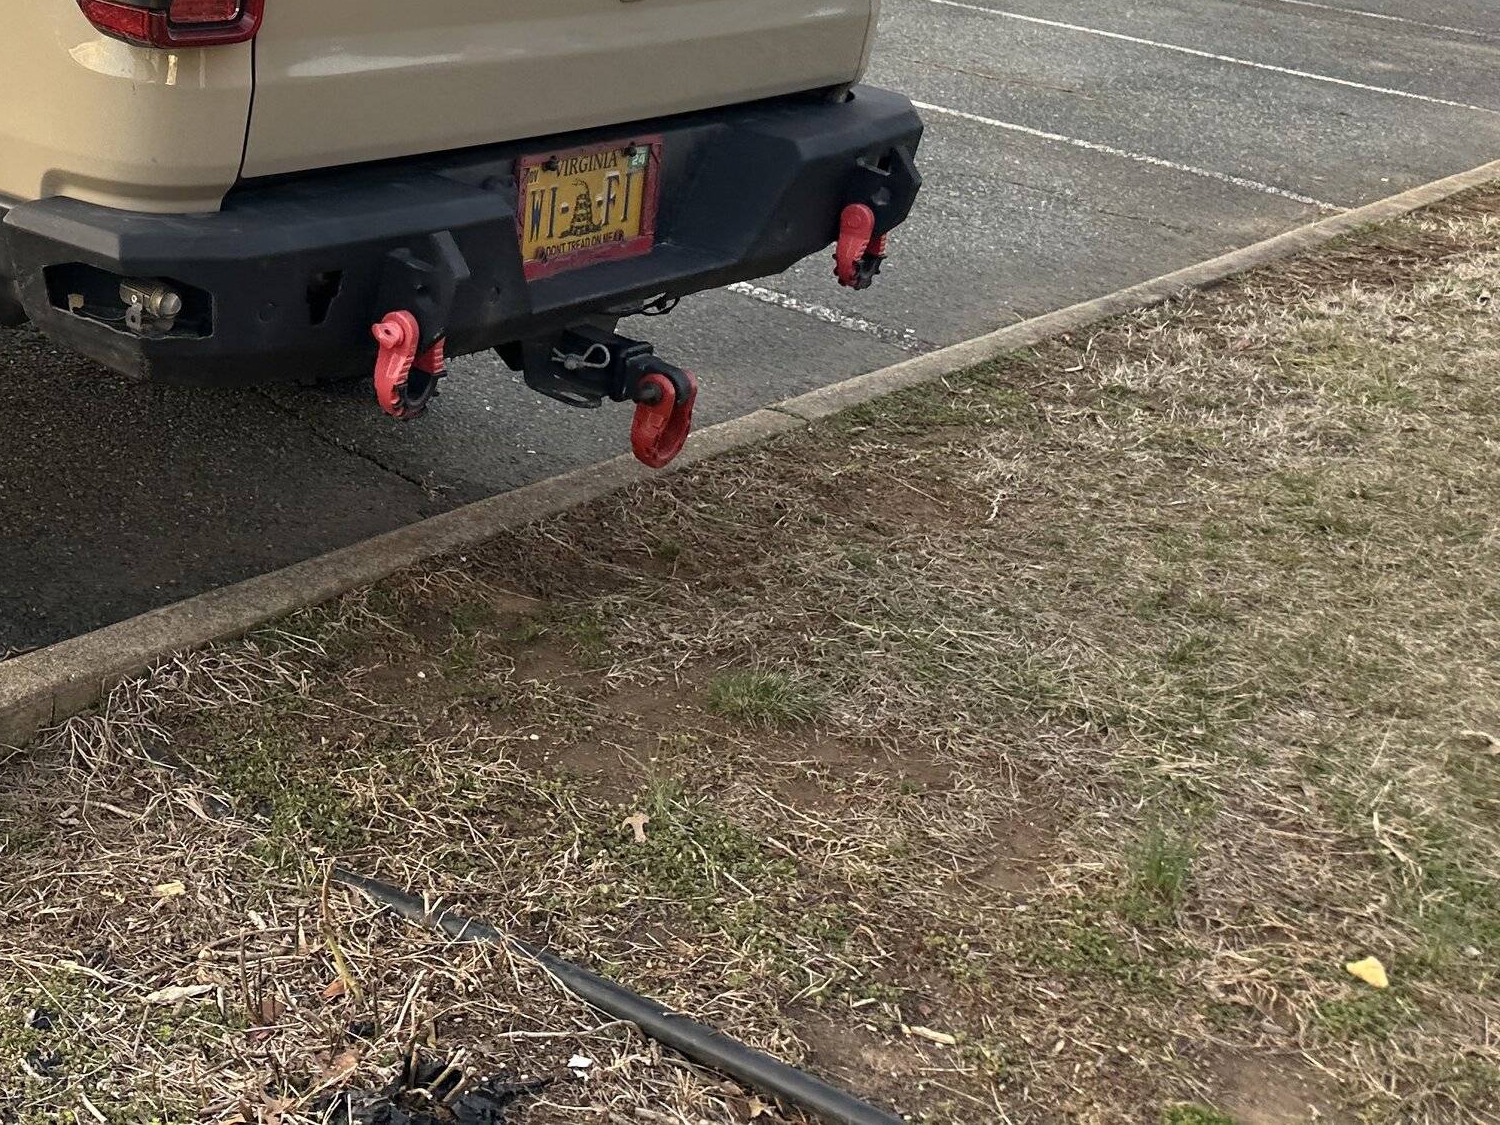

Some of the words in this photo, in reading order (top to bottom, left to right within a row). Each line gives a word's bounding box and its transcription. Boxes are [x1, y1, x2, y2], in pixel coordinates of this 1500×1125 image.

[555, 150, 618, 177] VIRGINIA
[631, 153, 646, 166] 24
[567, 237, 590, 251] TREAD
[591, 234, 602, 245] ON
